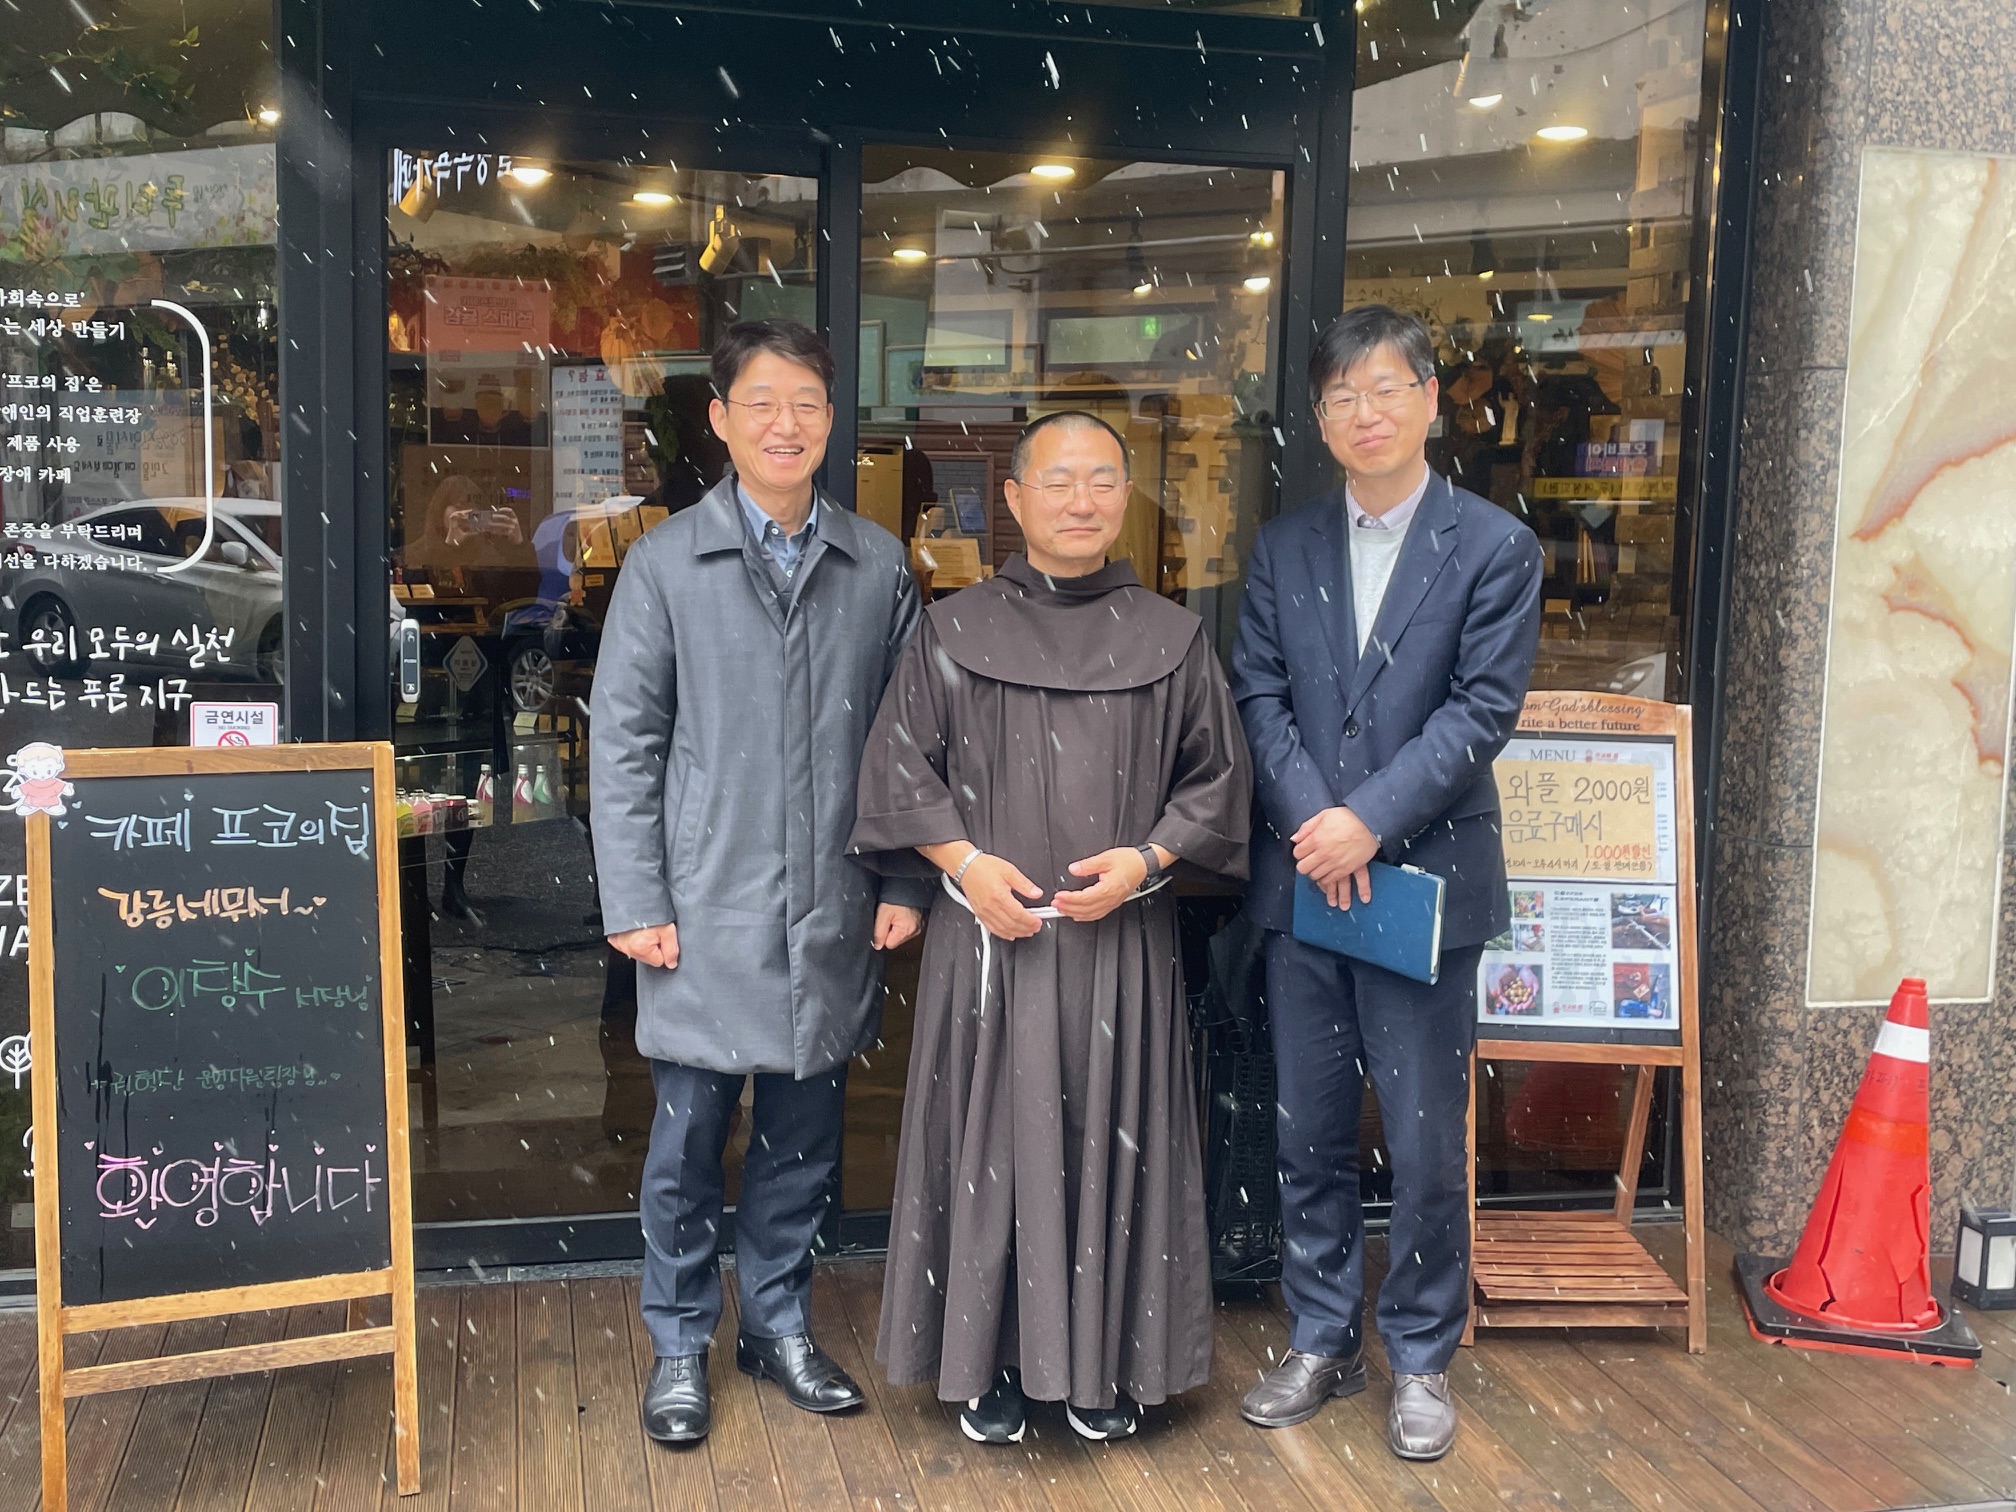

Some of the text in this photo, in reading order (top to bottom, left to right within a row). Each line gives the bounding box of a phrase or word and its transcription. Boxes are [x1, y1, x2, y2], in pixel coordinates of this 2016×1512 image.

[0, 317, 125, 340] 는 세상 만들기
[64, 375, 102, 393] 집'은
[0, 403, 142, 425] 애인의 직업훈련장
[6, 434, 81, 453] 제품 사용
[38, 466, 72, 484] 카페
[2, 522, 142, 541] 존중을 부탁드리며
[0, 552, 148, 571] 선을 다하겠습니다.
[22, 625, 77, 661] 우리
[89, 626, 160, 660] 모두의
[172, 623, 235, 668] 실천
[78, 673, 128, 713] 푸른
[139, 678, 193, 711] 지구
[1523, 702, 1543, 711] om
[204, 710, 264, 725] 금연시설
[1521, 716, 1641, 732] rite a better future
[1530, 748, 1576, 761] MENU
[1504, 770, 1561, 806] 와플
[1574, 776, 1651, 805] 2,000원
[85, 801, 371, 856] 카페 프코의집
[1502, 810, 1603, 843] 음료구매시
[96, 1153, 383, 1230] 환영합니다
